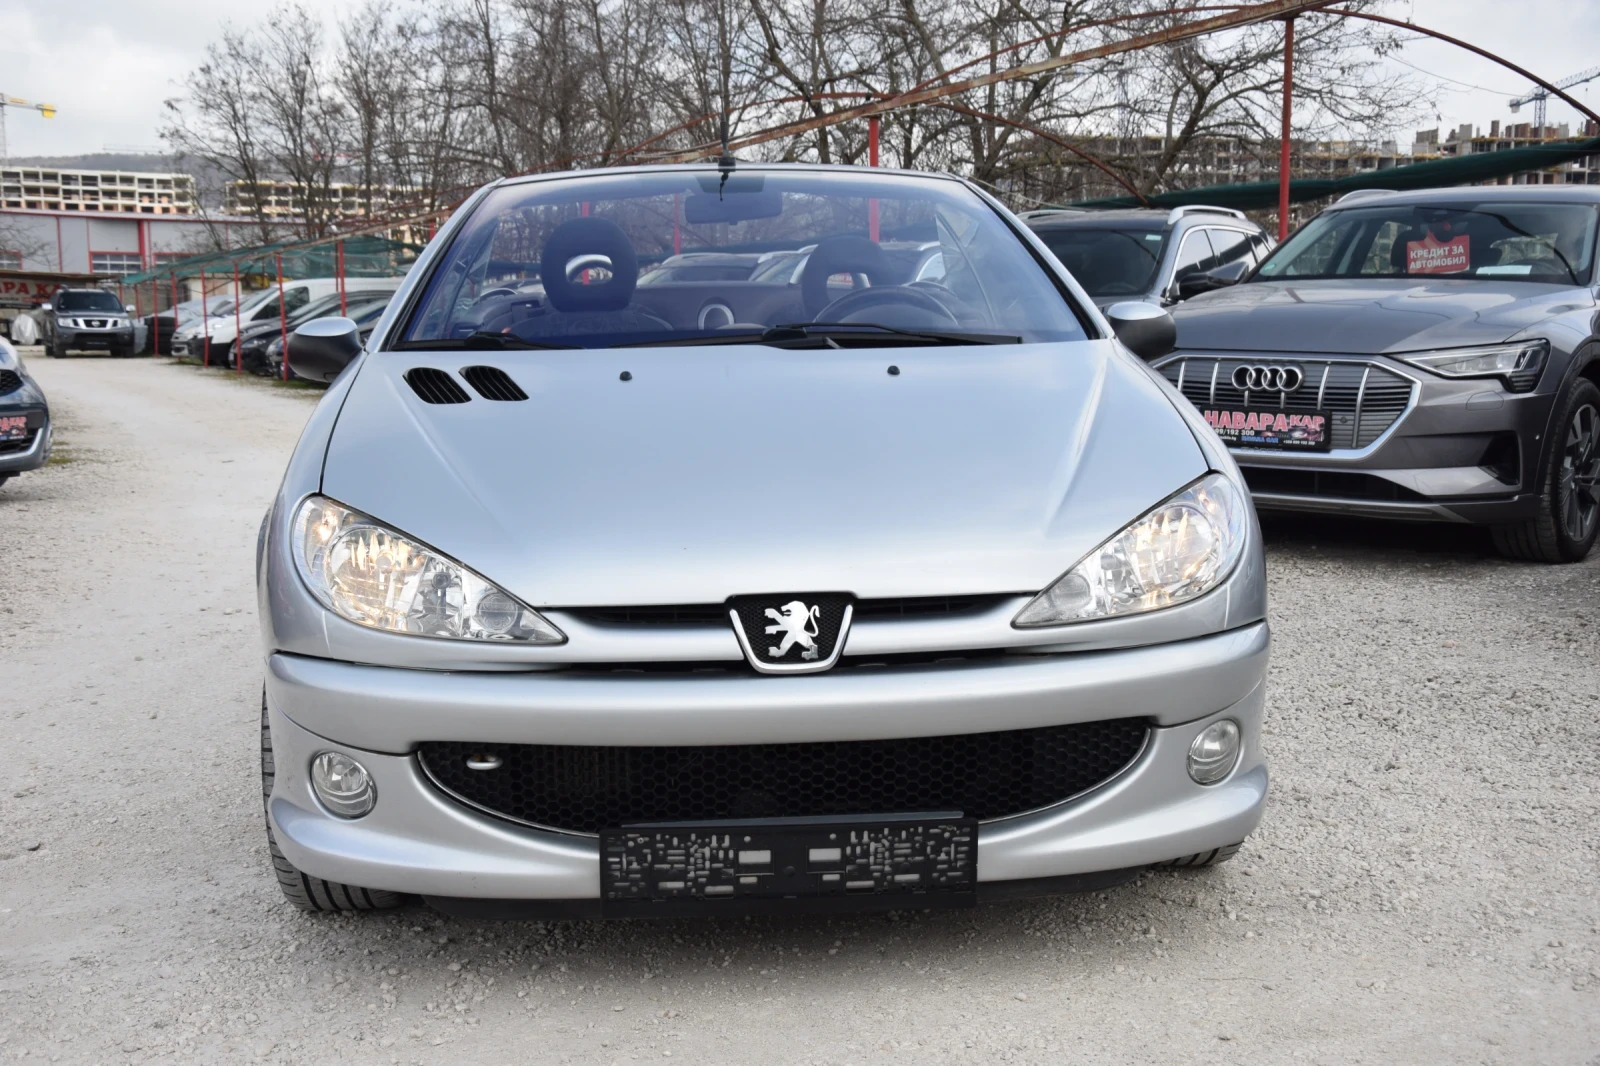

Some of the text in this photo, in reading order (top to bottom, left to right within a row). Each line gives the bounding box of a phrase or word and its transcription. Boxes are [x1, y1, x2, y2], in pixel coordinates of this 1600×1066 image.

[1410, 245, 1464, 259] КРЕДИТ ЗА
[1410, 256, 1466, 269] АВТОМОБИЛ
[0, 281, 30, 295] РА
[1204, 410, 1325, 431] НАВАРА КАР
